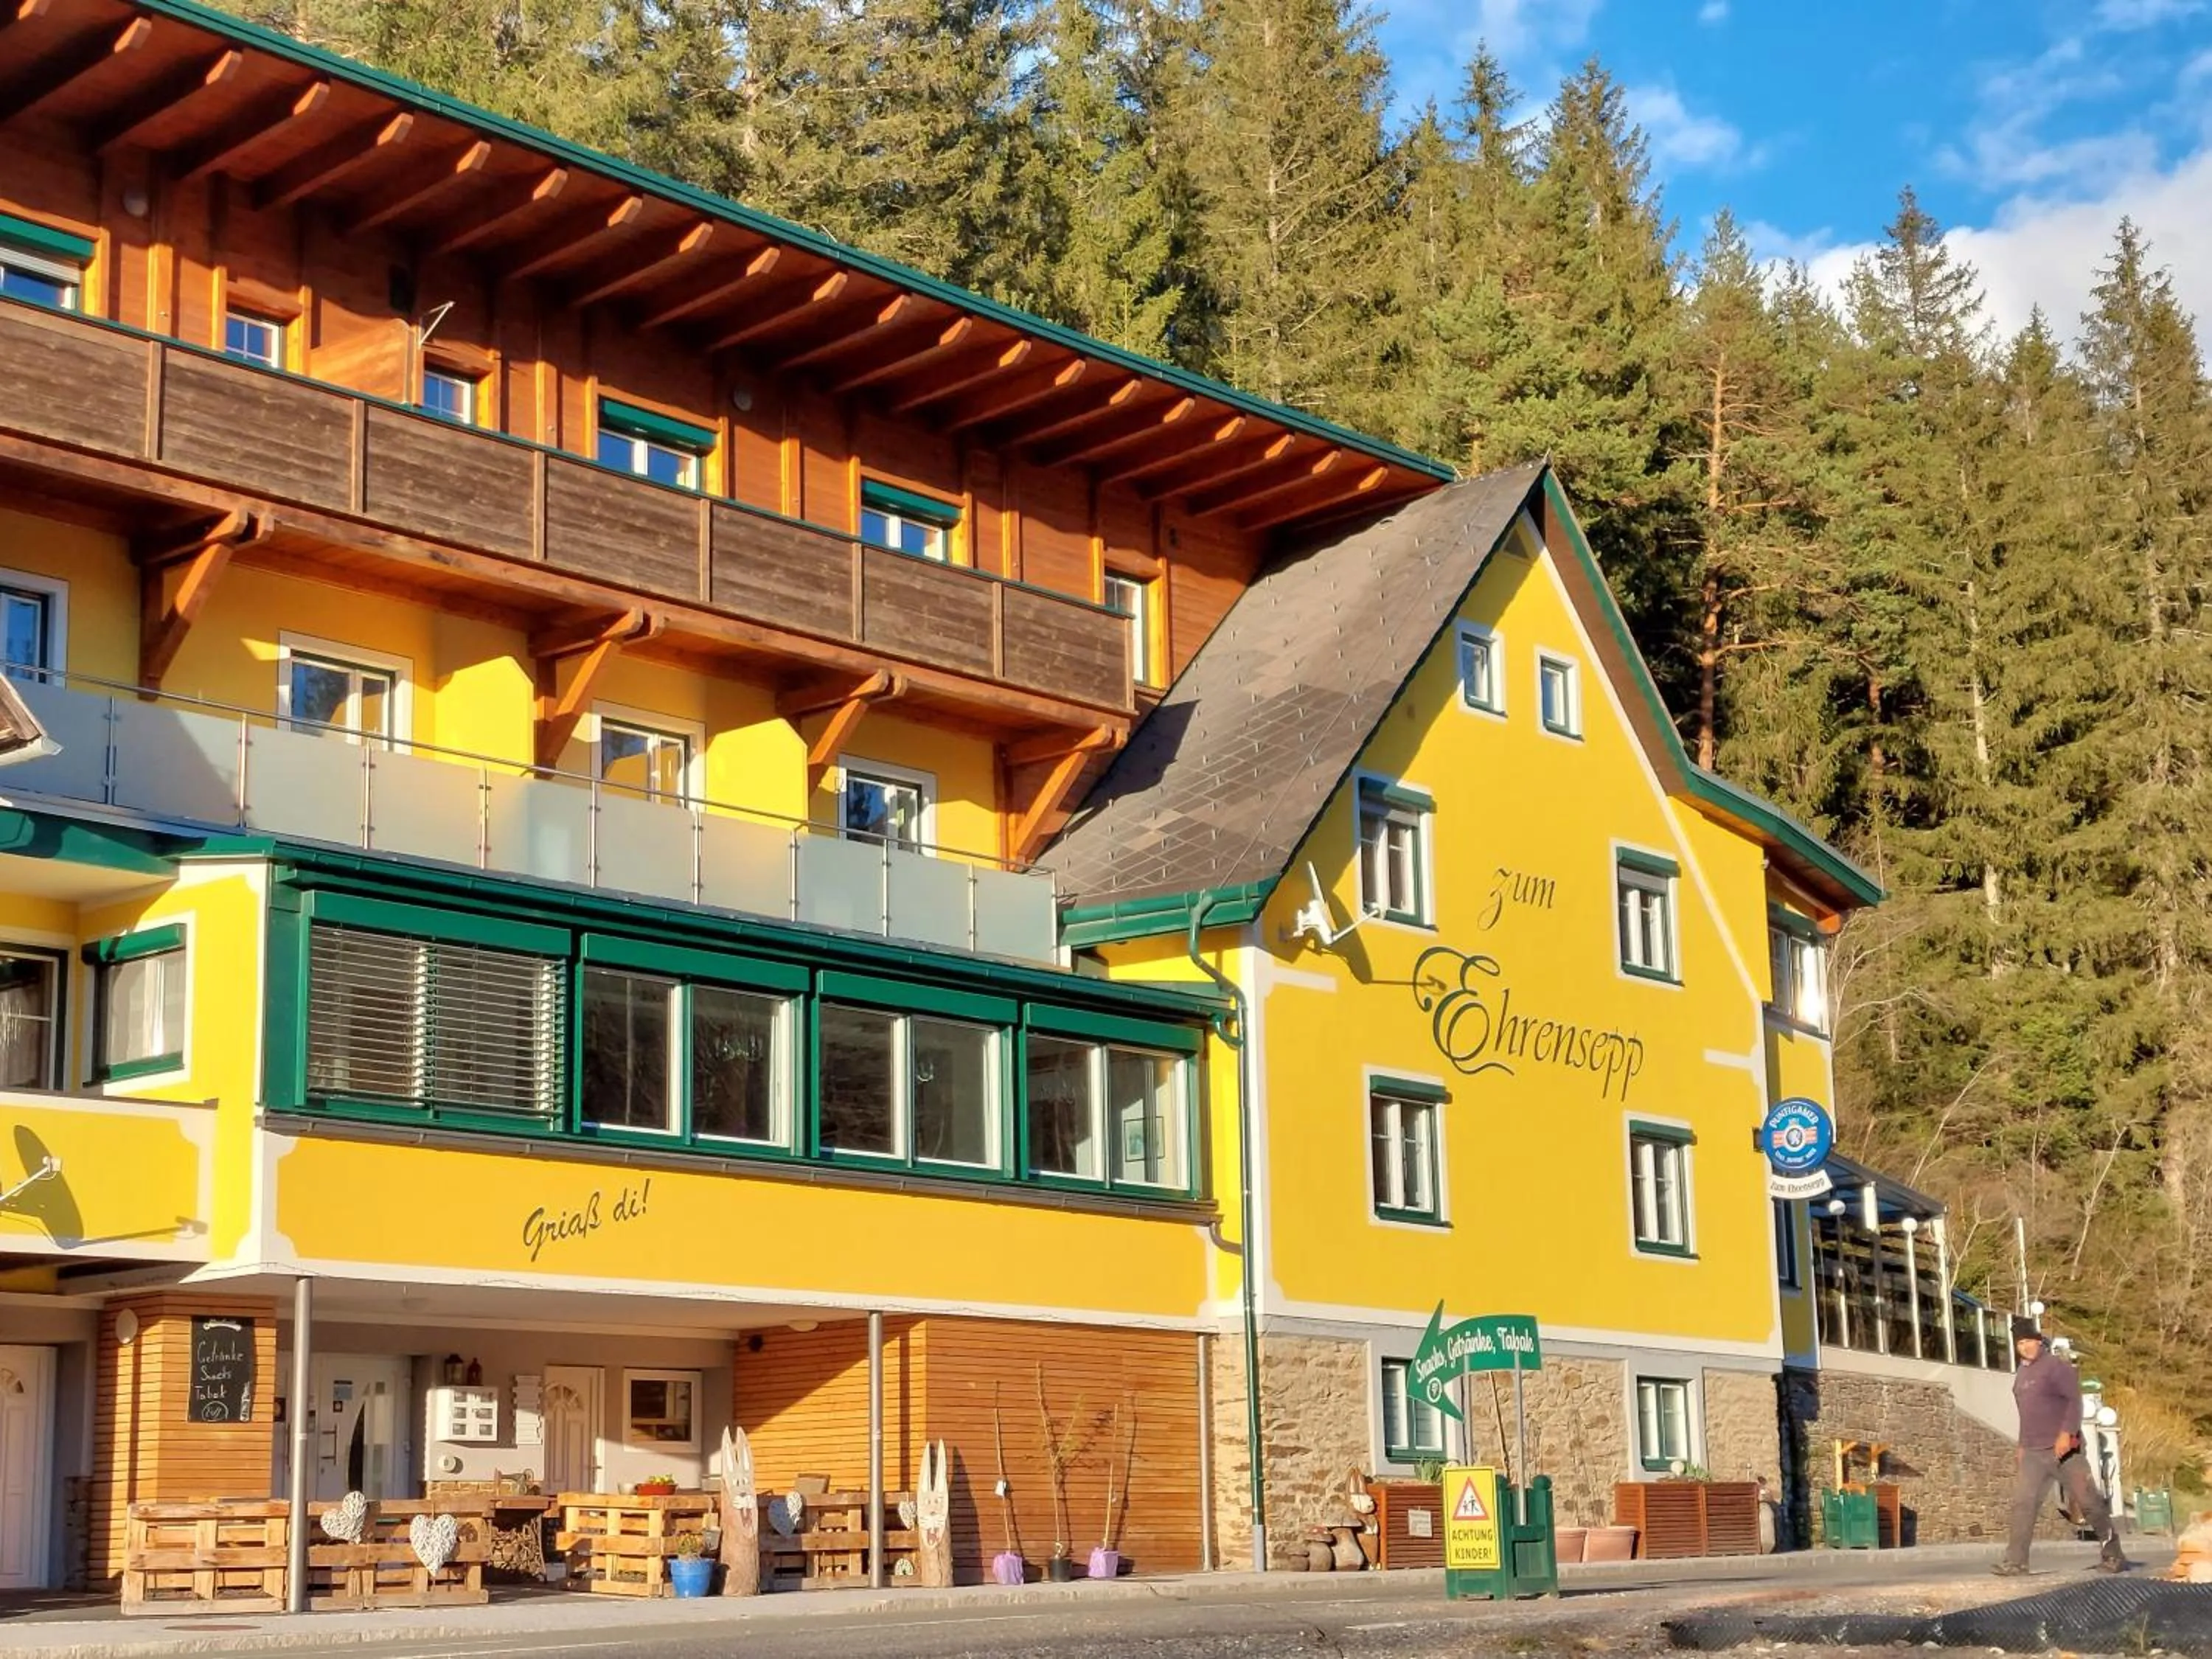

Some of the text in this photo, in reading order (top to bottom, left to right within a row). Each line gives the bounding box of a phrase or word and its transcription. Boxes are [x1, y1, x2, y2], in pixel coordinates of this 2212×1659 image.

[1477, 867, 1556, 932] zum
[1413, 946, 1644, 1102] Ehrensepp
[1769, 1105, 1819, 1129] PUNTIGAMER
[522, 1178, 650, 1262] Griaß di!
[1415, 1326, 1534, 1383] Snacks, Getränke, Tabak
[194, 1383, 228, 1400] Tabak
[1452, 1528, 1493, 1542] ACHTUNG
[1455, 1548, 1492, 1559] KINDER!
